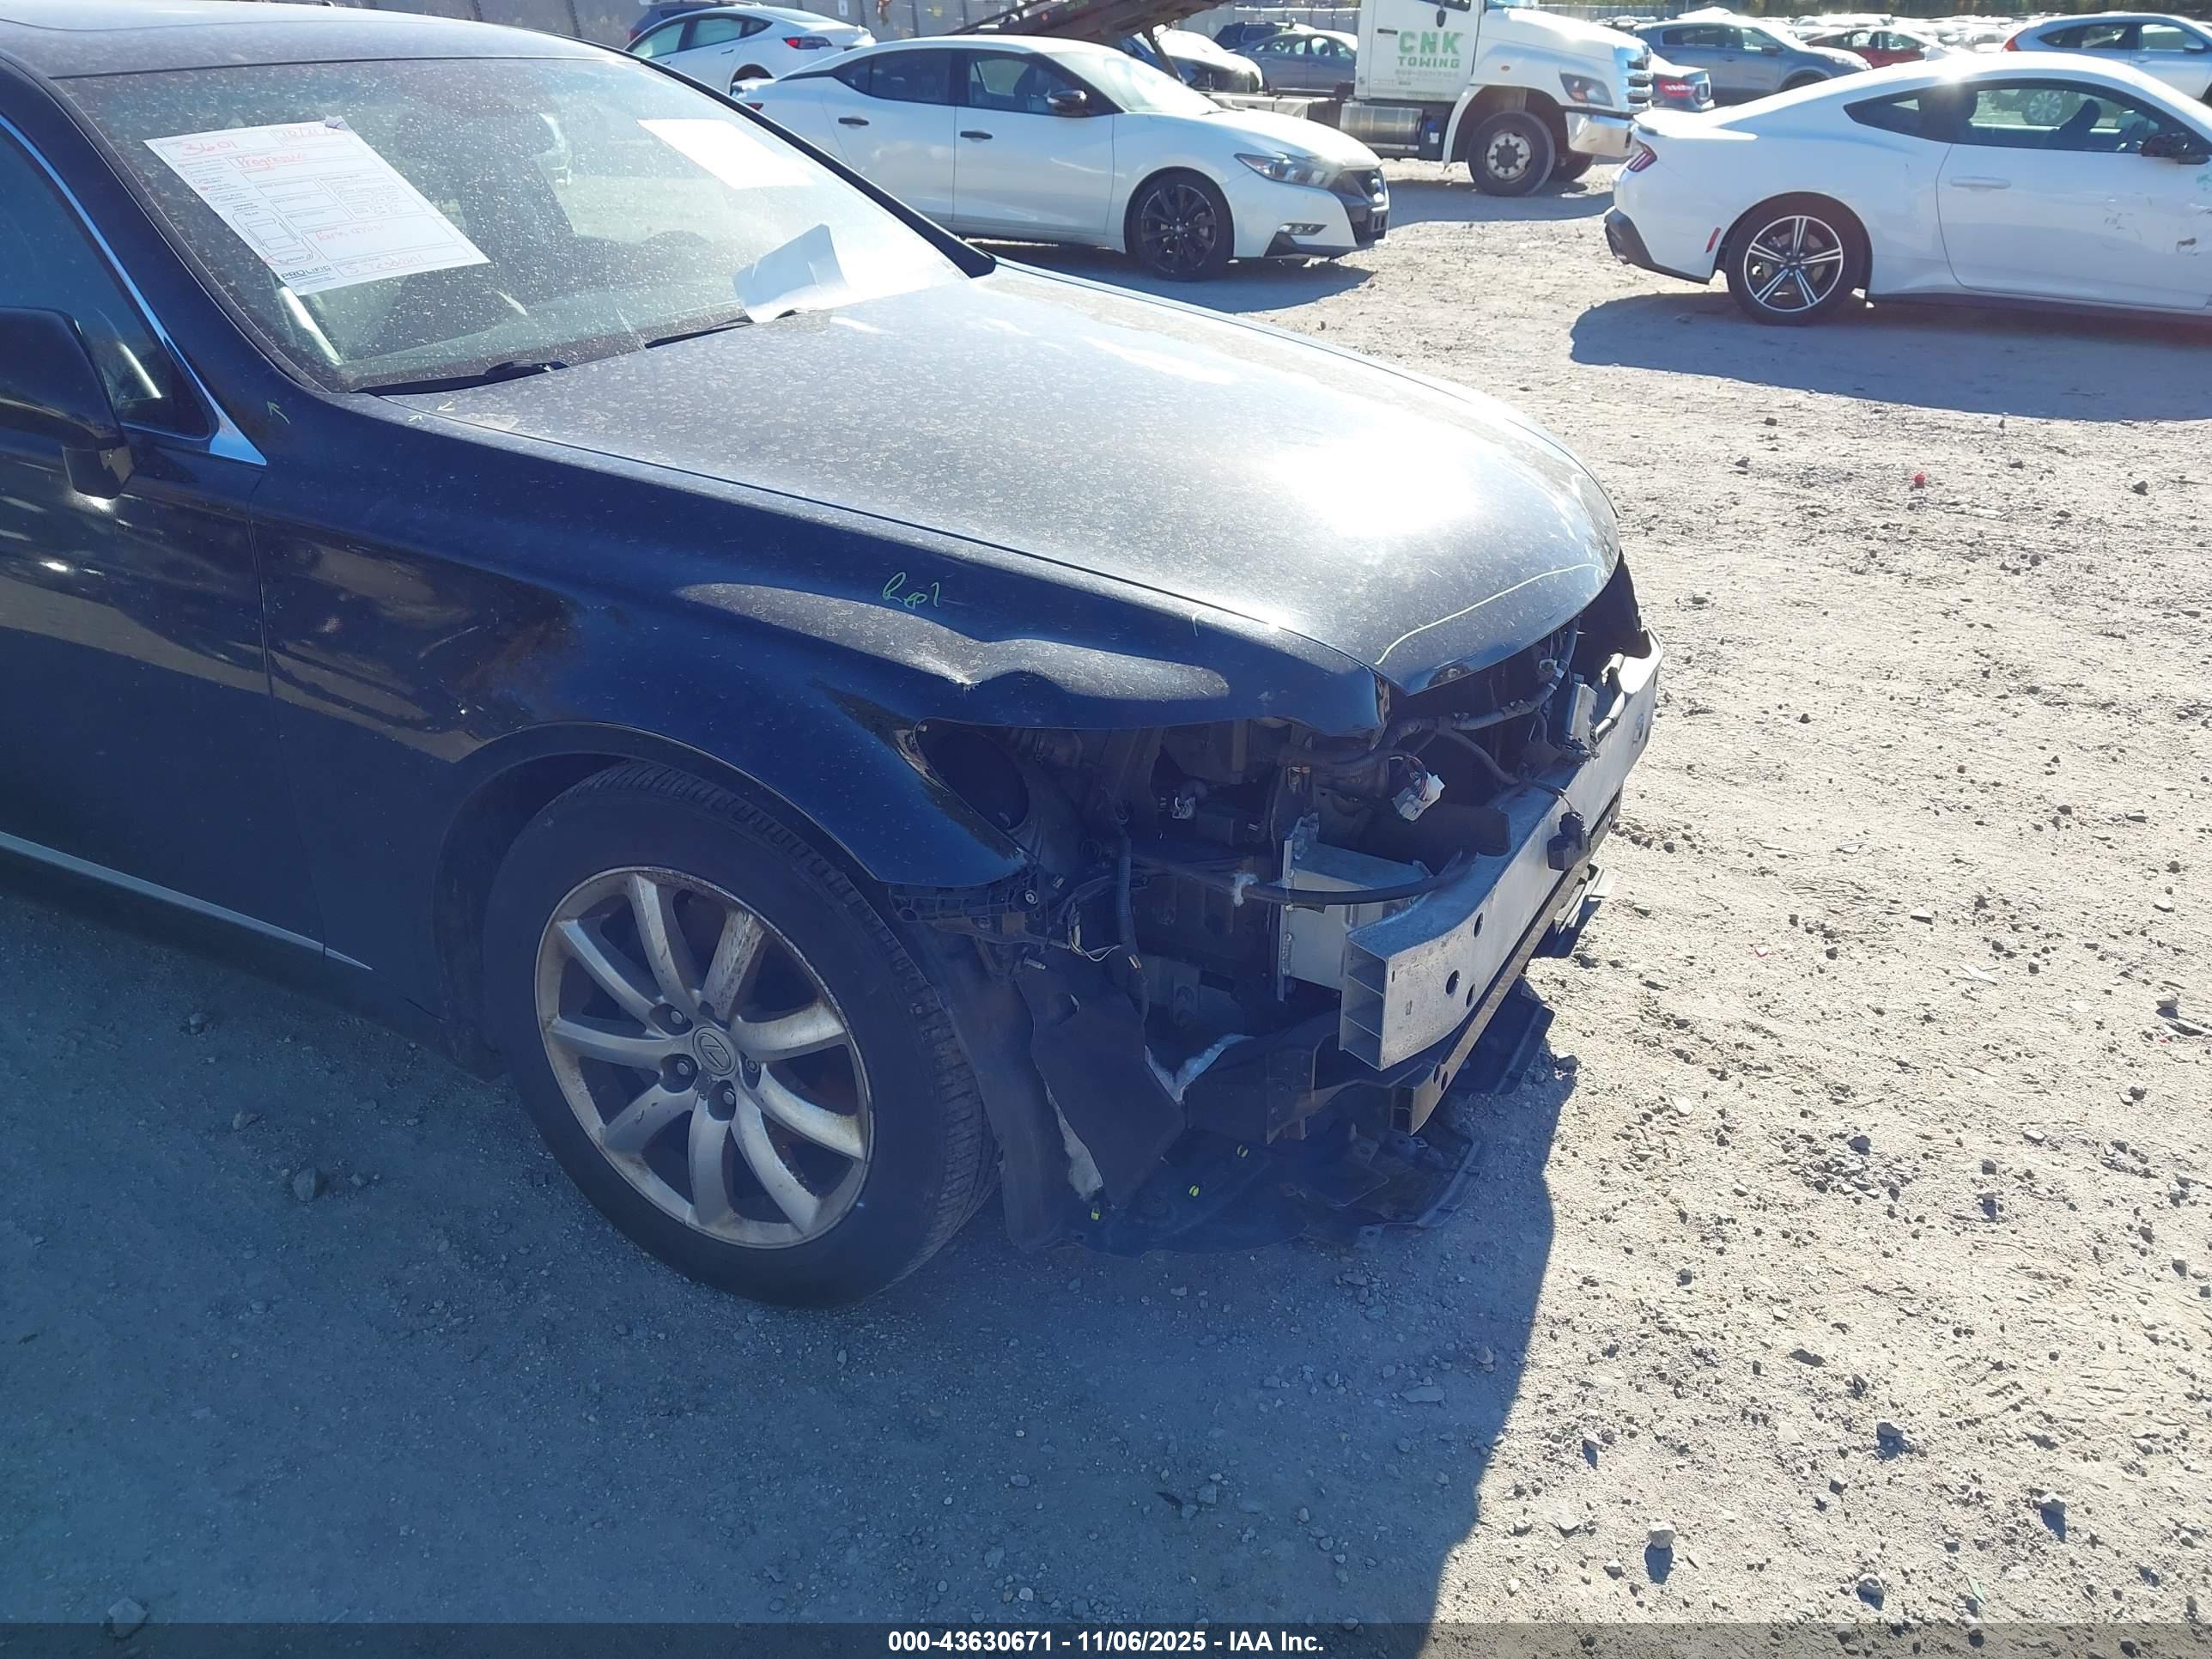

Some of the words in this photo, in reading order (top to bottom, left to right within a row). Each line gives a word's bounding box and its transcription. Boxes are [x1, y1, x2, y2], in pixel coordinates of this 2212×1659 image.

[1400, 29, 1463, 54] CNK
[1396, 56, 1462, 69] TOWING
[280, 264, 332, 279] PROLIFIC
